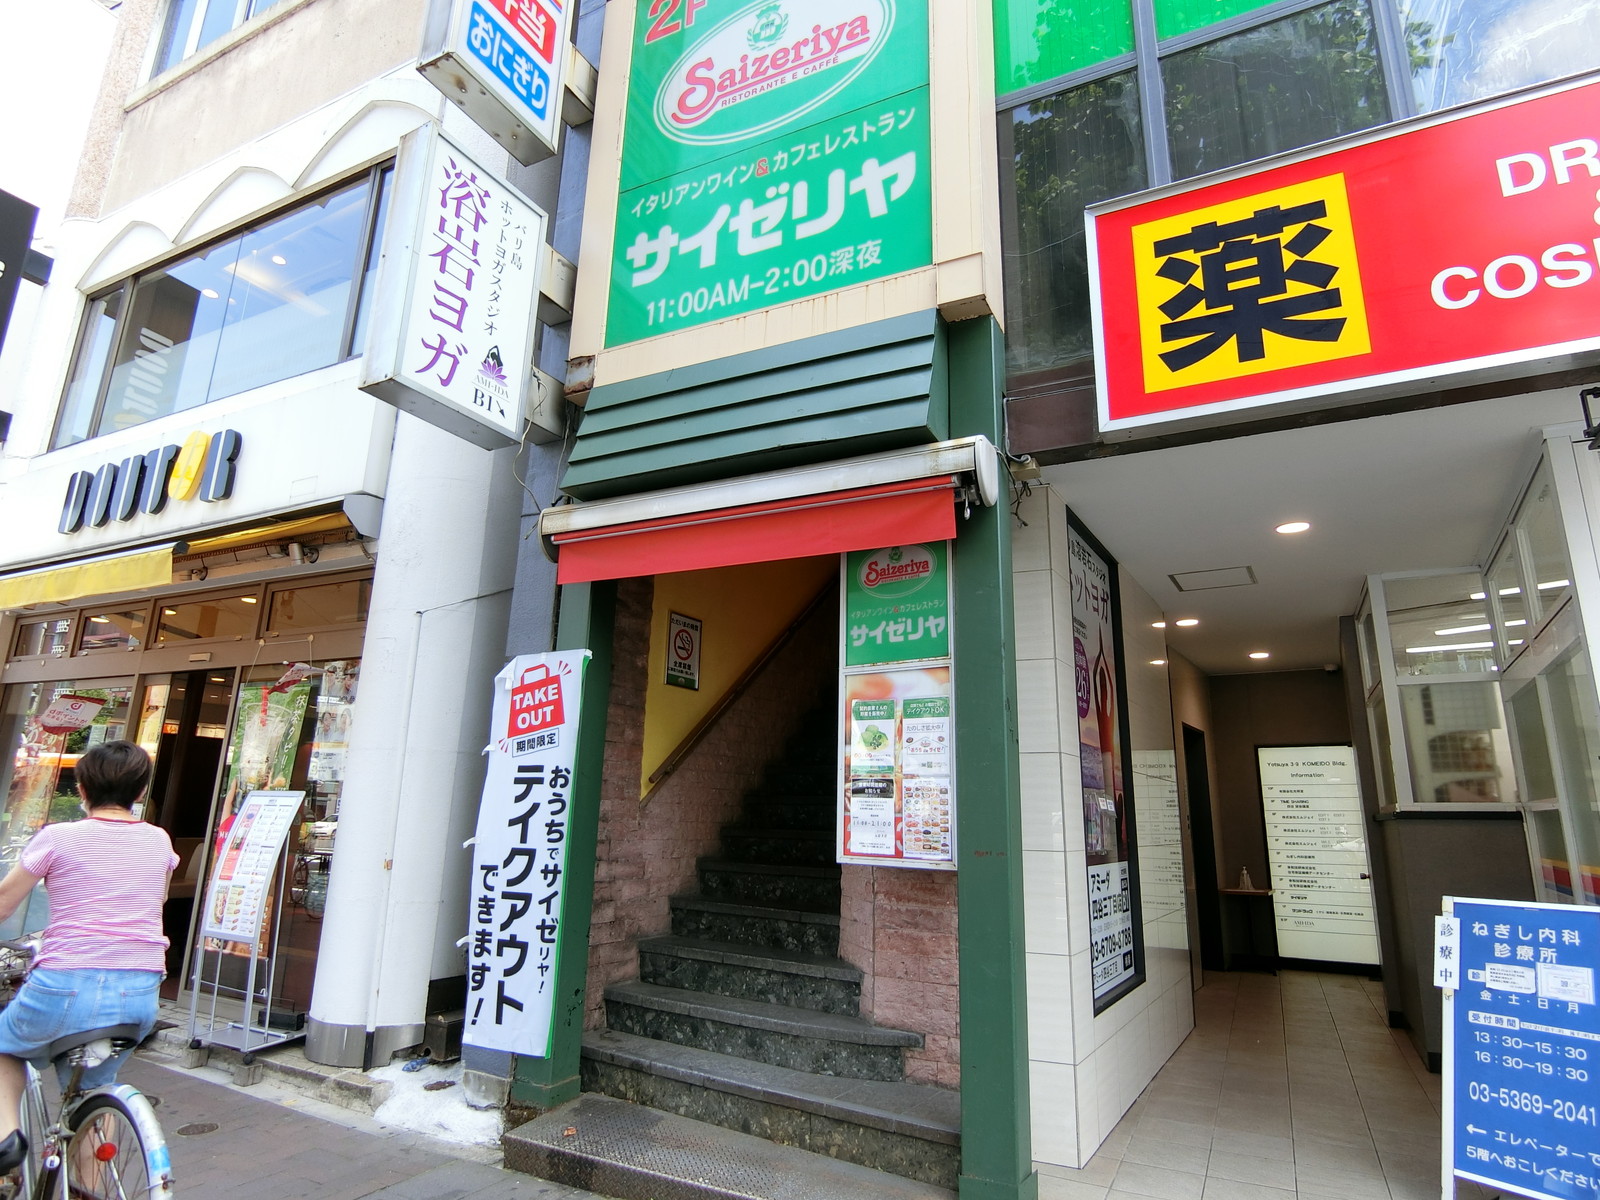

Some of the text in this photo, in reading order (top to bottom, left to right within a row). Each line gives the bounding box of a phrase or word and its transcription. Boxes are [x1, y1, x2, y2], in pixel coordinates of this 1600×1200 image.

[470, 12, 547, 110] おにぎり
[671, 14, 870, 125] Saizeriya
[721, 75, 787, 108] RISTORANTE
[791, 72, 798, 81] E
[626, 151, 916, 288] サイゼリヤ
[484, 200, 513, 336] ホットヨガスタジオ
[511, 223, 527, 271] バリ島
[414, 155, 492, 388] 溶岩ヨガ
[1153, 199, 1348, 372] 薬
[473, 386, 493, 413] B1
[58, 428, 242, 535] DOUTOR
[864, 559, 930, 588] Saizeriya
[1070, 568, 1109, 624] ットヨガ
[850, 615, 947, 647] サイゼリヤ
[512, 683, 559, 710] TAKE
[516, 705, 554, 729] OUT
[516, 732, 557, 753] 期間限定
[494, 764, 545, 1025] テイクアウト
[1091, 869, 1110, 894] アミーダ
[470, 864, 499, 1026] できます!
[1439, 923, 1454, 983] 診療中
[1472, 921, 1581, 946] ねぎし内科
[1493, 942, 1558, 964] 診療所
[1471, 1012, 1517, 1028] 受付時間
[1469, 1081, 1598, 1127] 03-5369-2041
